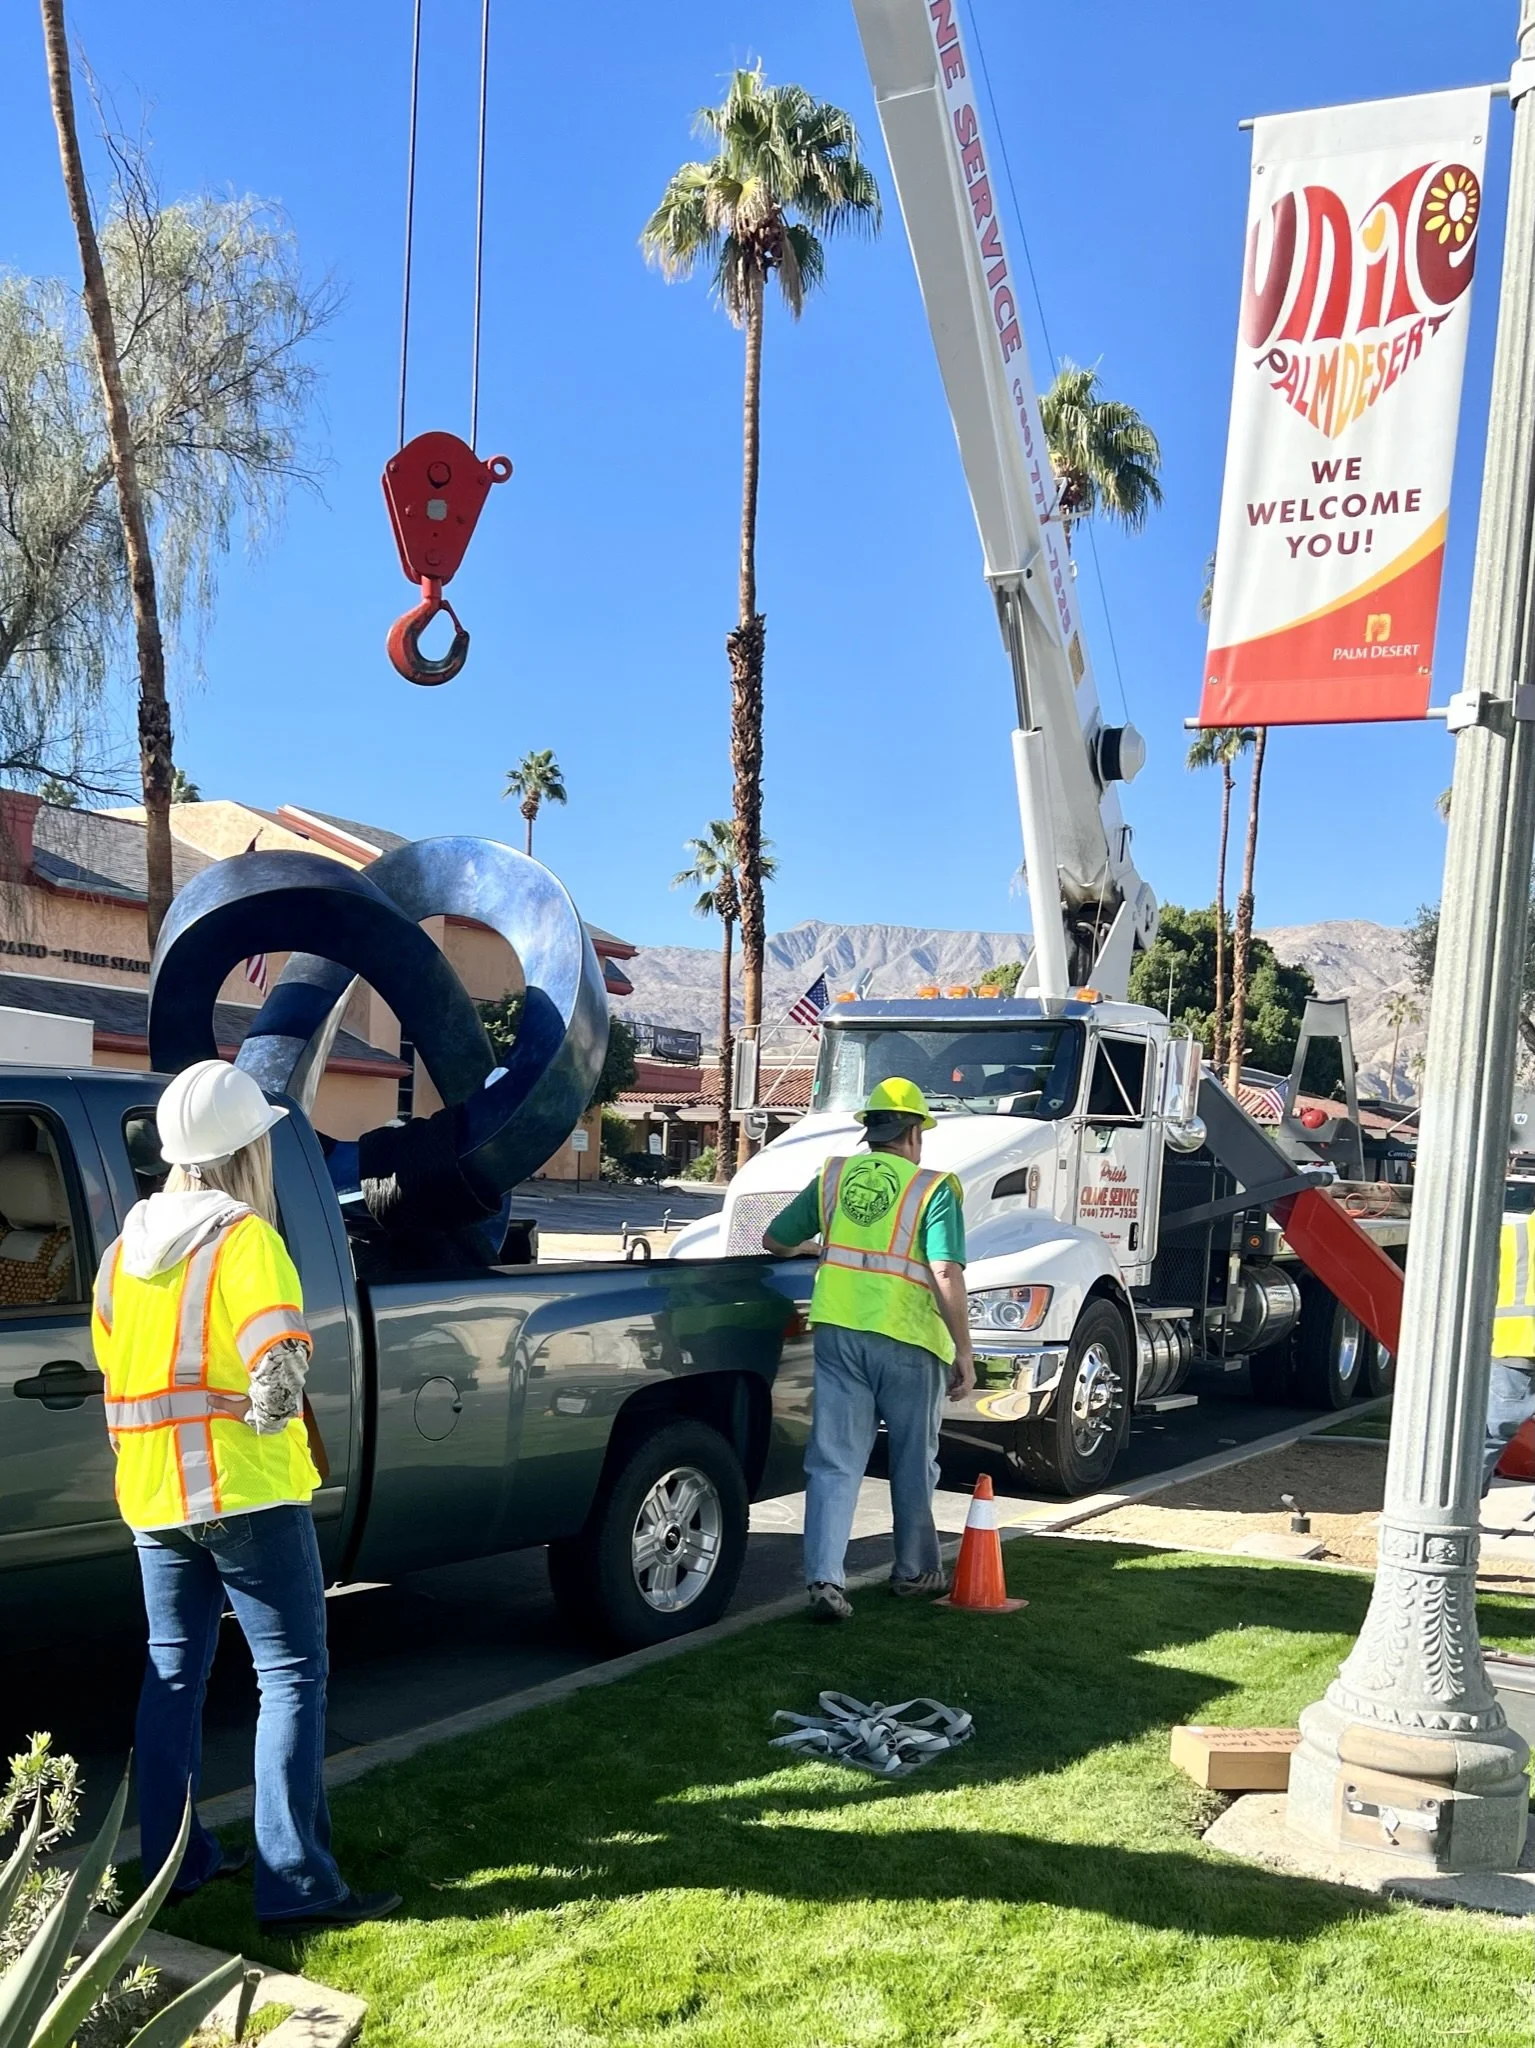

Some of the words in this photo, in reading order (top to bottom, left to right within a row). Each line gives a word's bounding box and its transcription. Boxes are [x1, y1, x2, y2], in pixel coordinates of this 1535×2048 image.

[930, 0, 966, 89] NE
[954, 103, 1022, 364] SERVICE
[1311, 456, 1362, 484] WE
[1247, 488, 1422, 527] WELCOME
[1286, 529, 1373, 559] YOU!
[1333, 647, 1368, 661] PALM
[1371, 644, 1420, 659] DESERT
[1080, 1186, 1108, 1206] CRANE
[1109, 1187, 1140, 1207] SERVICE
[1099, 1207, 1138, 1219] 777-7325
